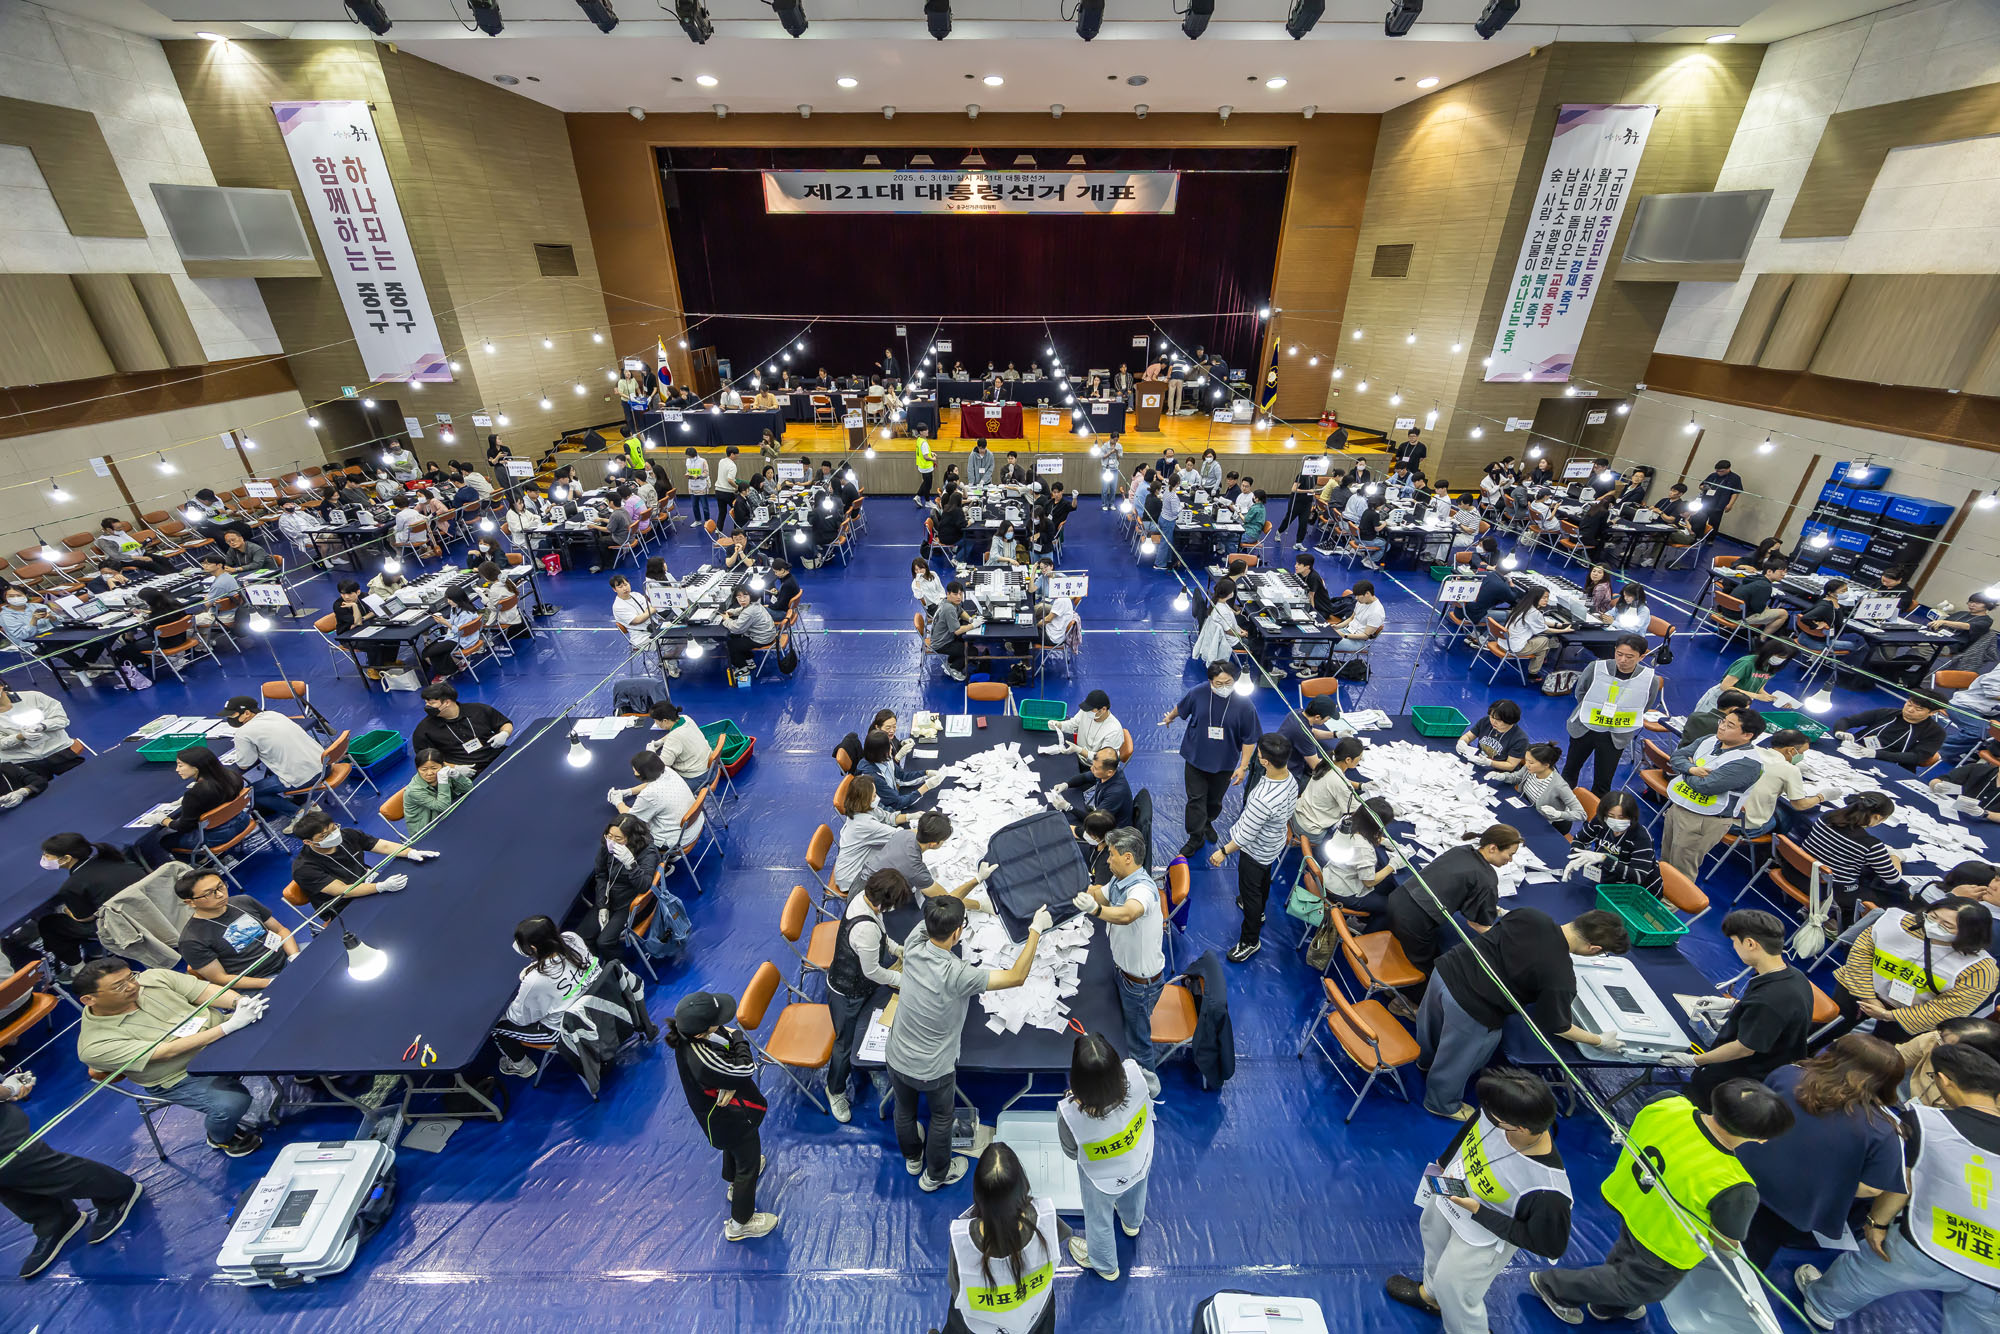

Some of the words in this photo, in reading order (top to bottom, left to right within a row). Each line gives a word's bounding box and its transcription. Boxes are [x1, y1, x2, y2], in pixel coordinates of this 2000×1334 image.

[803, 183, 904, 201] 제21대
[915, 183, 1065, 202] 대통령선거
[1076, 183, 1136, 201] 개표
[893, 174, 916, 182] 2025.
[919, 174, 928, 182] 6.
[930, 174, 953, 182] 3.(화)
[956, 174, 973, 182] 실시
[976, 174, 1002, 182] 제21대
[1005, 174, 1046, 182] 대통령선거
[1552, 168, 1580, 226] 남녀노소
[1573, 168, 1596, 212] 사람이
[1589, 168, 1613, 212] 활기가
[1604, 168, 1628, 212] 구민이
[312, 156, 370, 272] 함께하는
[356, 282, 389, 334] 중구
[341, 156, 397, 271] 하나되는
[384, 281, 417, 334] 중구
[1540, 229, 1561, 271] 행복한
[1556, 215, 1582, 271] 돌아오는
[1574, 215, 1597, 257] 넘치는
[1585, 215, 1613, 271] 주인되는
[1531, 273, 1548, 300] 복지
[1546, 273, 1563, 300] 교육
[1565, 260, 1583, 287] 경제
[1577, 274, 1594, 300] 중구
[1507, 274, 1532, 327] 하나되는
[1522, 303, 1539, 328] 중구
[1537, 303, 1554, 328] 중구
[1556, 290, 1573, 316] 중구
[1500, 329, 1516, 354] 중구
[1092, 1116, 1144, 1155] 개표참관
[1466, 1129, 1495, 1196] 개표참관
[1945, 1214, 1995, 1242] 질서있는
[1945, 1227, 2000, 1264] 개표
